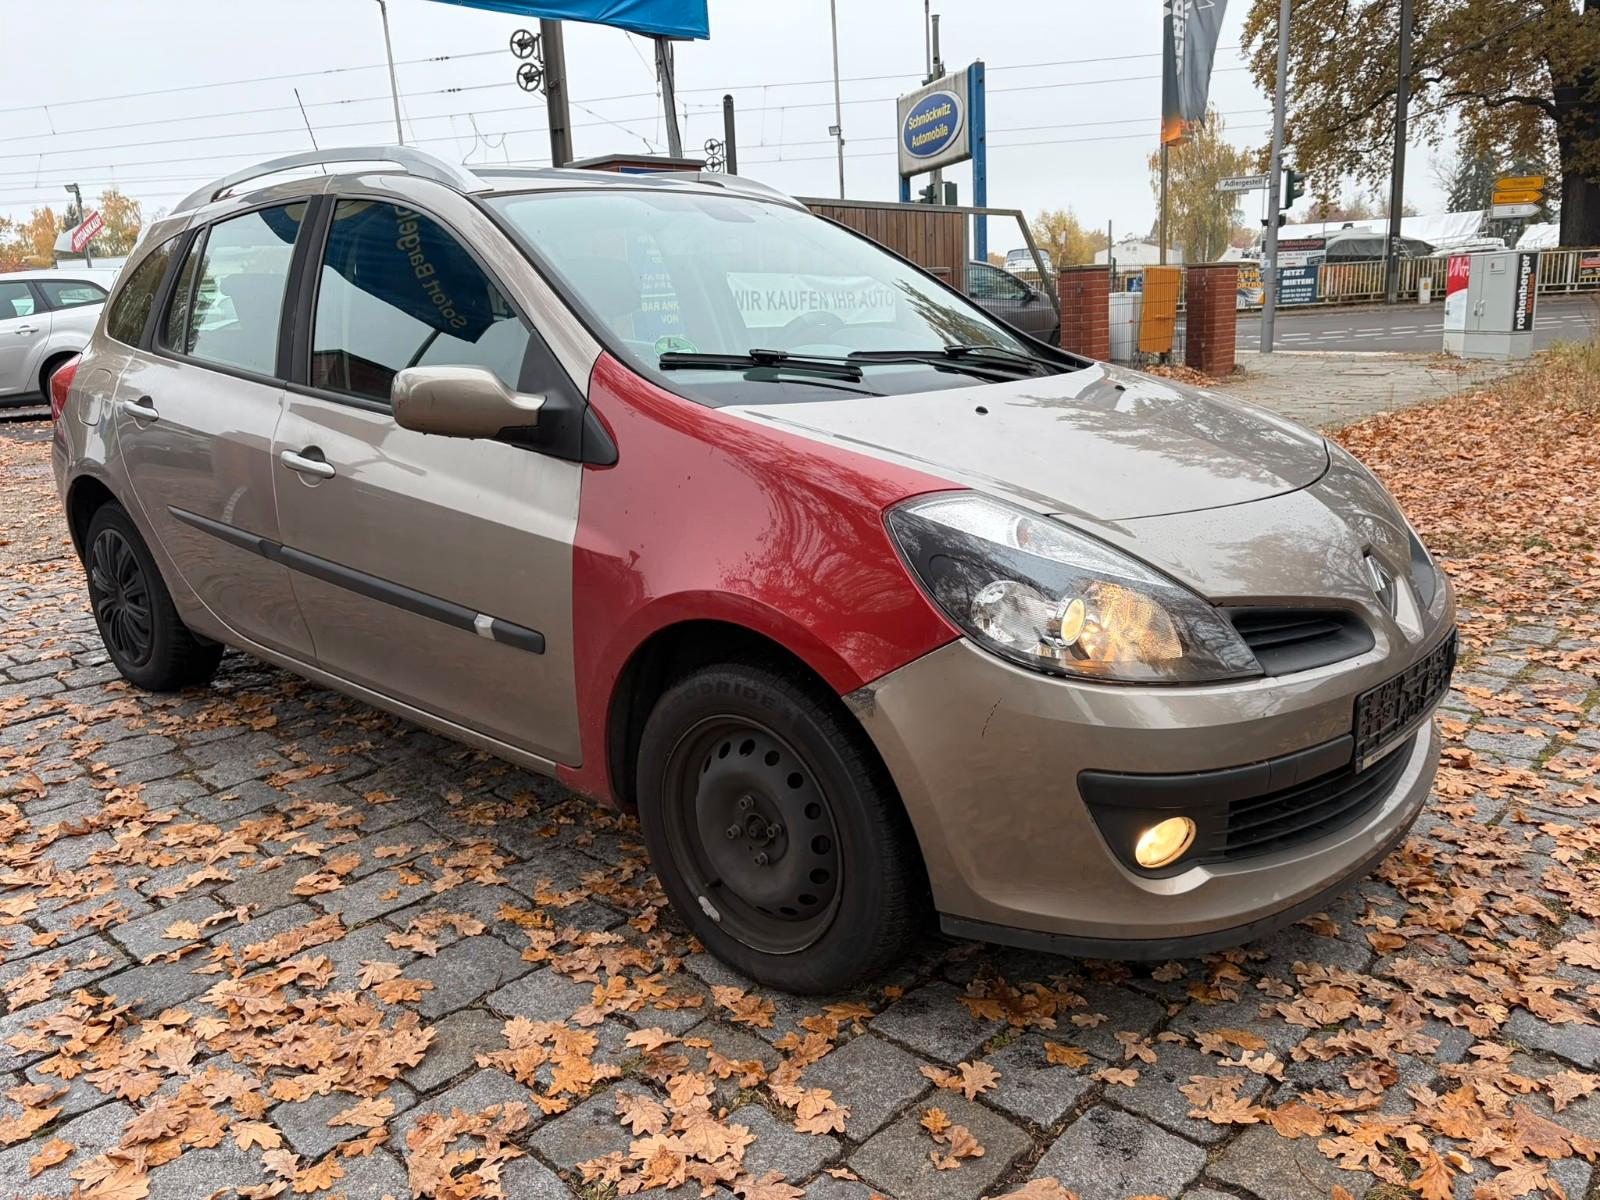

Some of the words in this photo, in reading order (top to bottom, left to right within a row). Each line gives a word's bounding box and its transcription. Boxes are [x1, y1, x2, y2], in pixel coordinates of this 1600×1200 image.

[908, 103, 951, 130] Schmöckwitz
[912, 123, 948, 148] Automobile
[1224, 178, 1263, 188] Adlergestell
[767, 290, 827, 311] KAUFEN
[831, 290, 856, 310] IHR
[858, 289, 894, 309] AUTO
[1516, 254, 1531, 330] rothenberger
